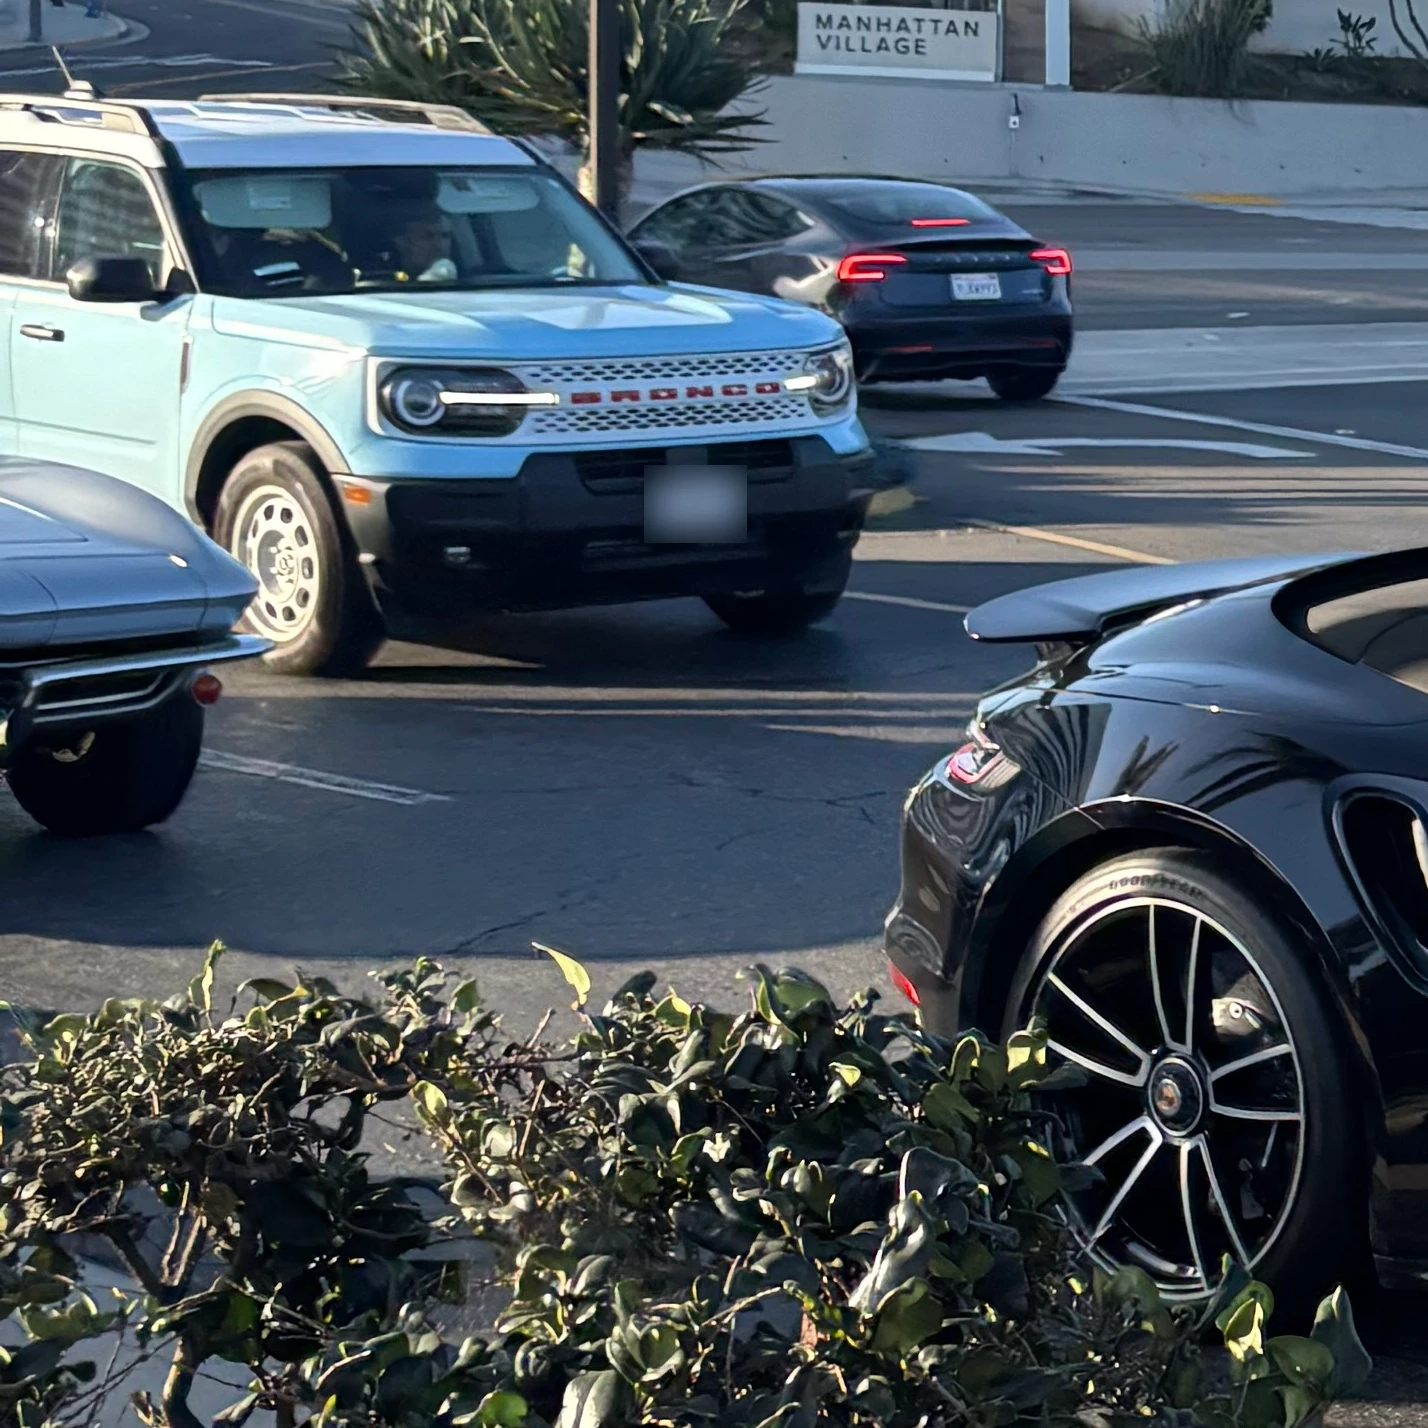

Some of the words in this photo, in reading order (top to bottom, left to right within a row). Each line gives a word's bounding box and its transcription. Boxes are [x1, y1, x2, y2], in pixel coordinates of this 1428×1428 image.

[815, 13, 980, 38] MANHATTAN
[815, 33, 928, 56] VILLAGE
[570, 381, 781, 405] BRONCO
